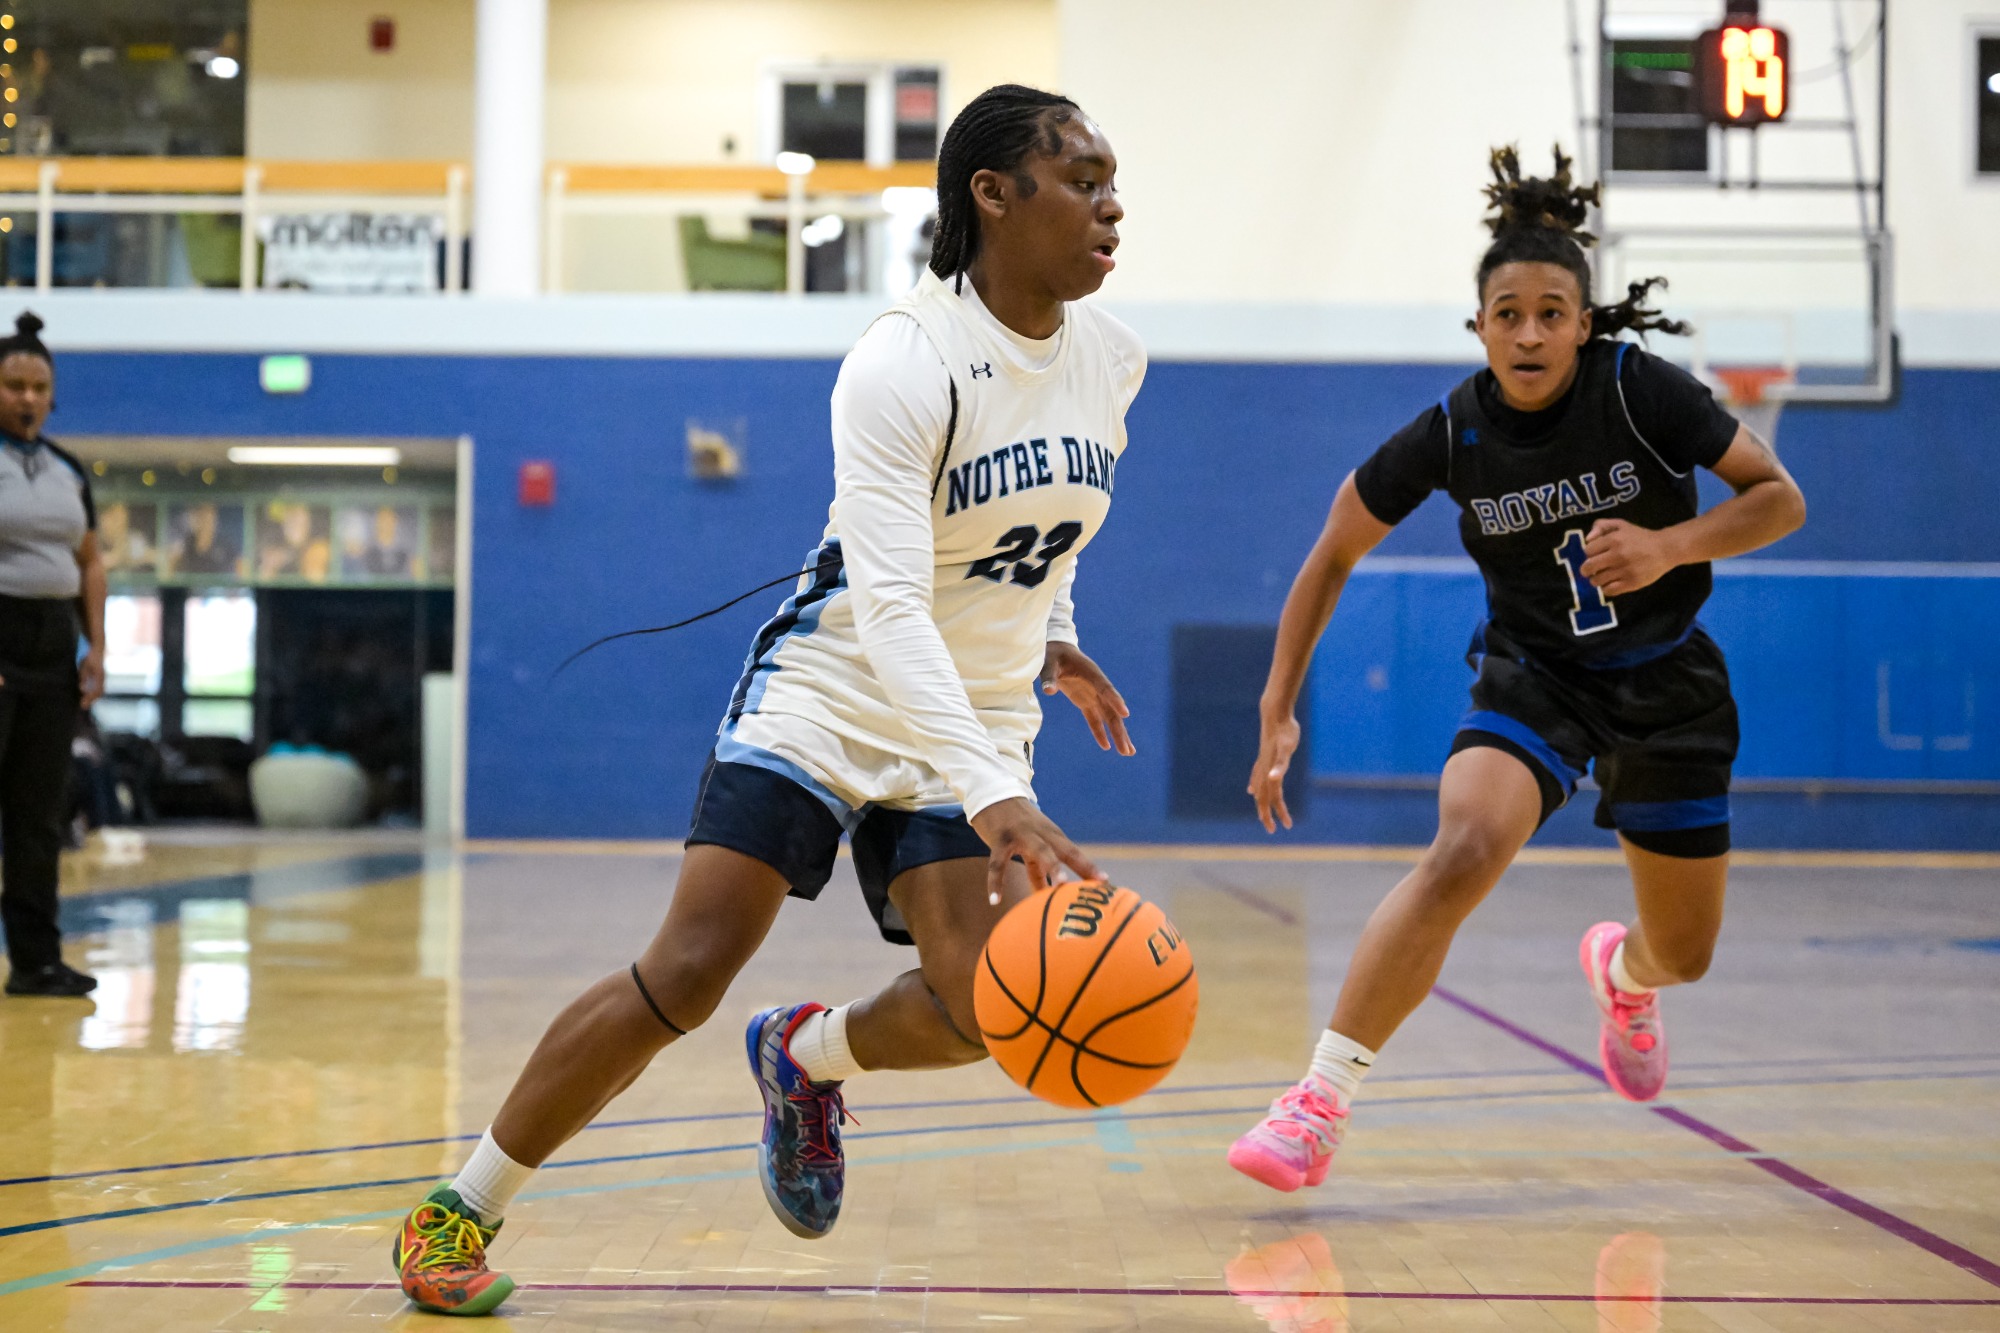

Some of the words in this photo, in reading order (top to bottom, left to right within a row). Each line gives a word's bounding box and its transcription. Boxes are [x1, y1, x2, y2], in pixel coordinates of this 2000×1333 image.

[1725, 54, 1783, 118] 14
[271, 211, 434, 252] molten
[945, 437, 1054, 517] NOTRE
[1470, 460, 1641, 535] ROYALS
[963, 520, 1083, 590] 23
[1553, 529, 1618, 636] 1
[1145, 918, 1182, 967] EV
